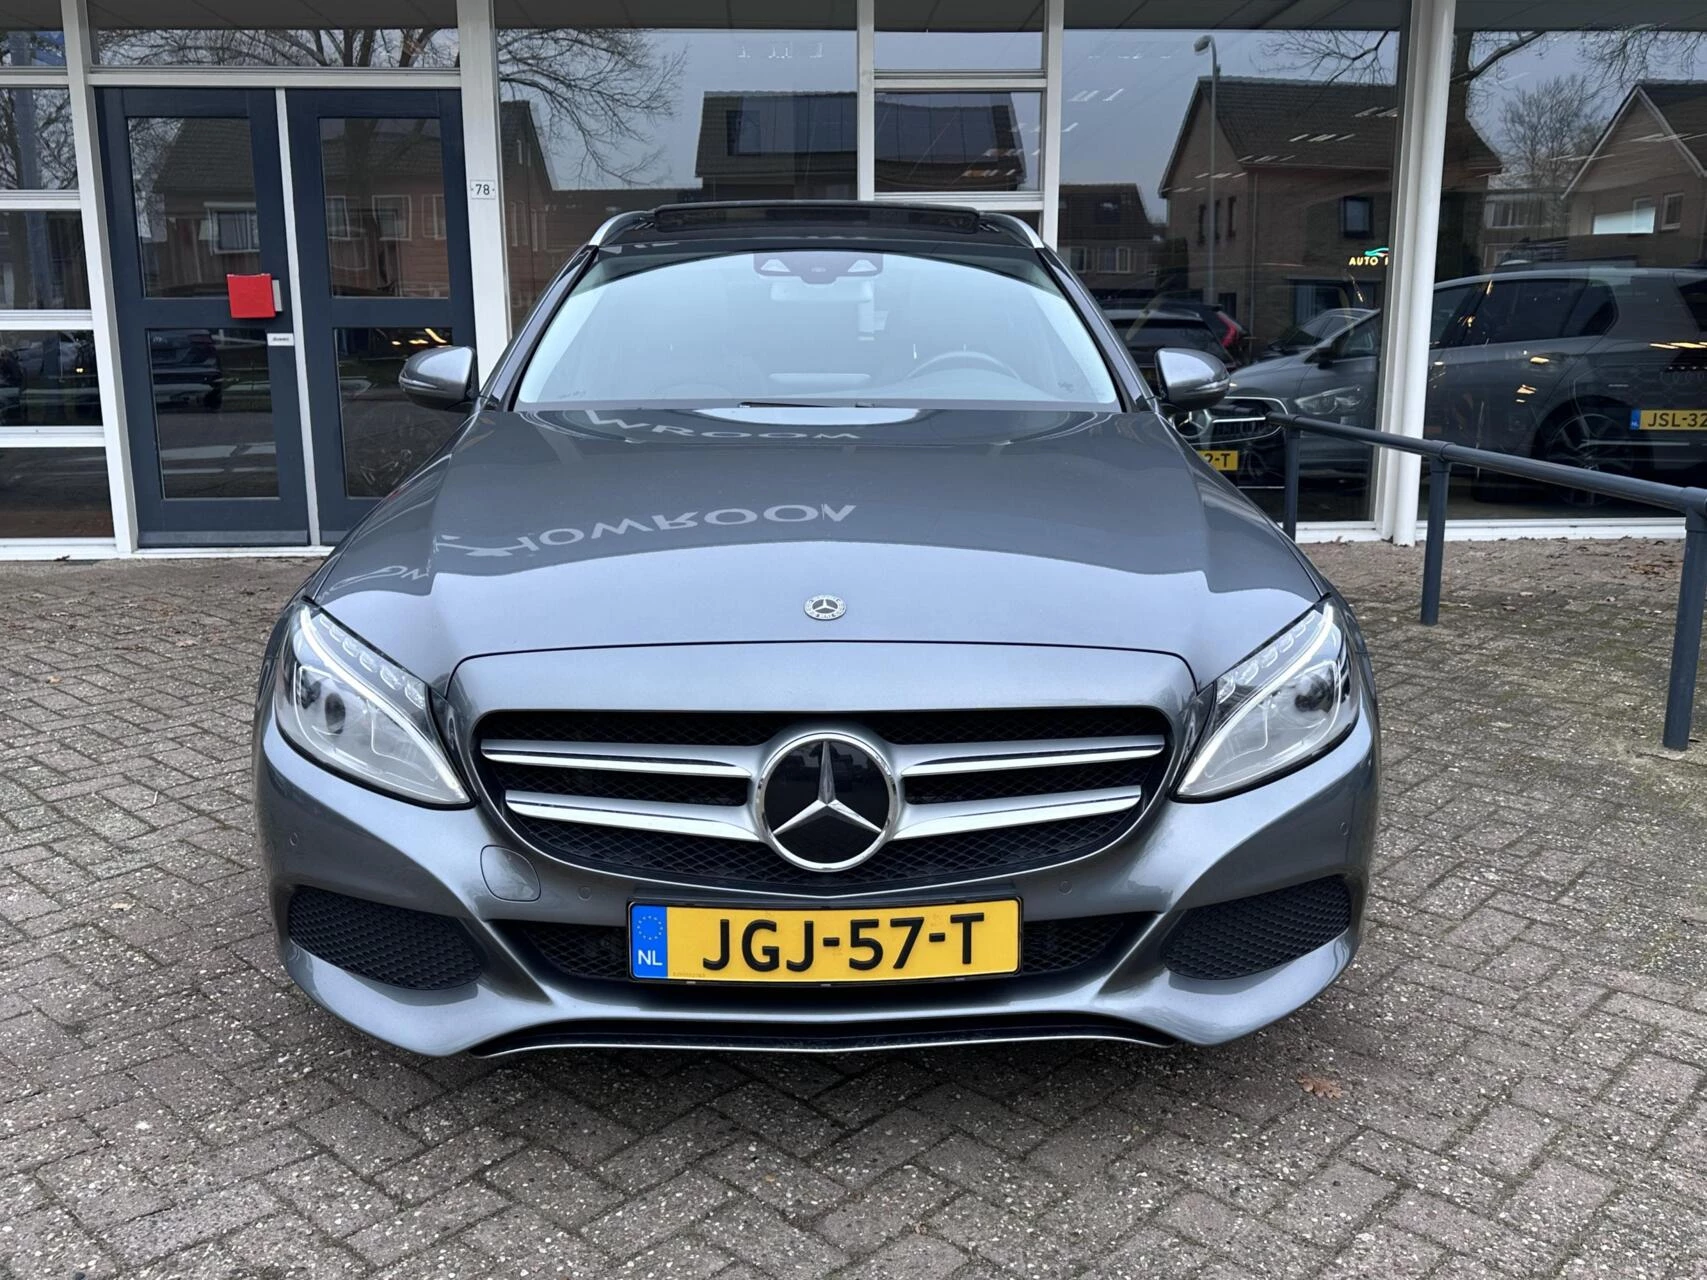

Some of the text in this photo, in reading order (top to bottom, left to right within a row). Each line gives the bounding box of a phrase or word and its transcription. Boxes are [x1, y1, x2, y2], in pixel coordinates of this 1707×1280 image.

[475, 183, 490, 196] 78
[1348, 256, 1379, 266] AUTO
[1647, 412, 1707, 428] JSL-32
[702, 912, 985, 973] JGJ-57-T
[637, 949, 663, 967] NL
